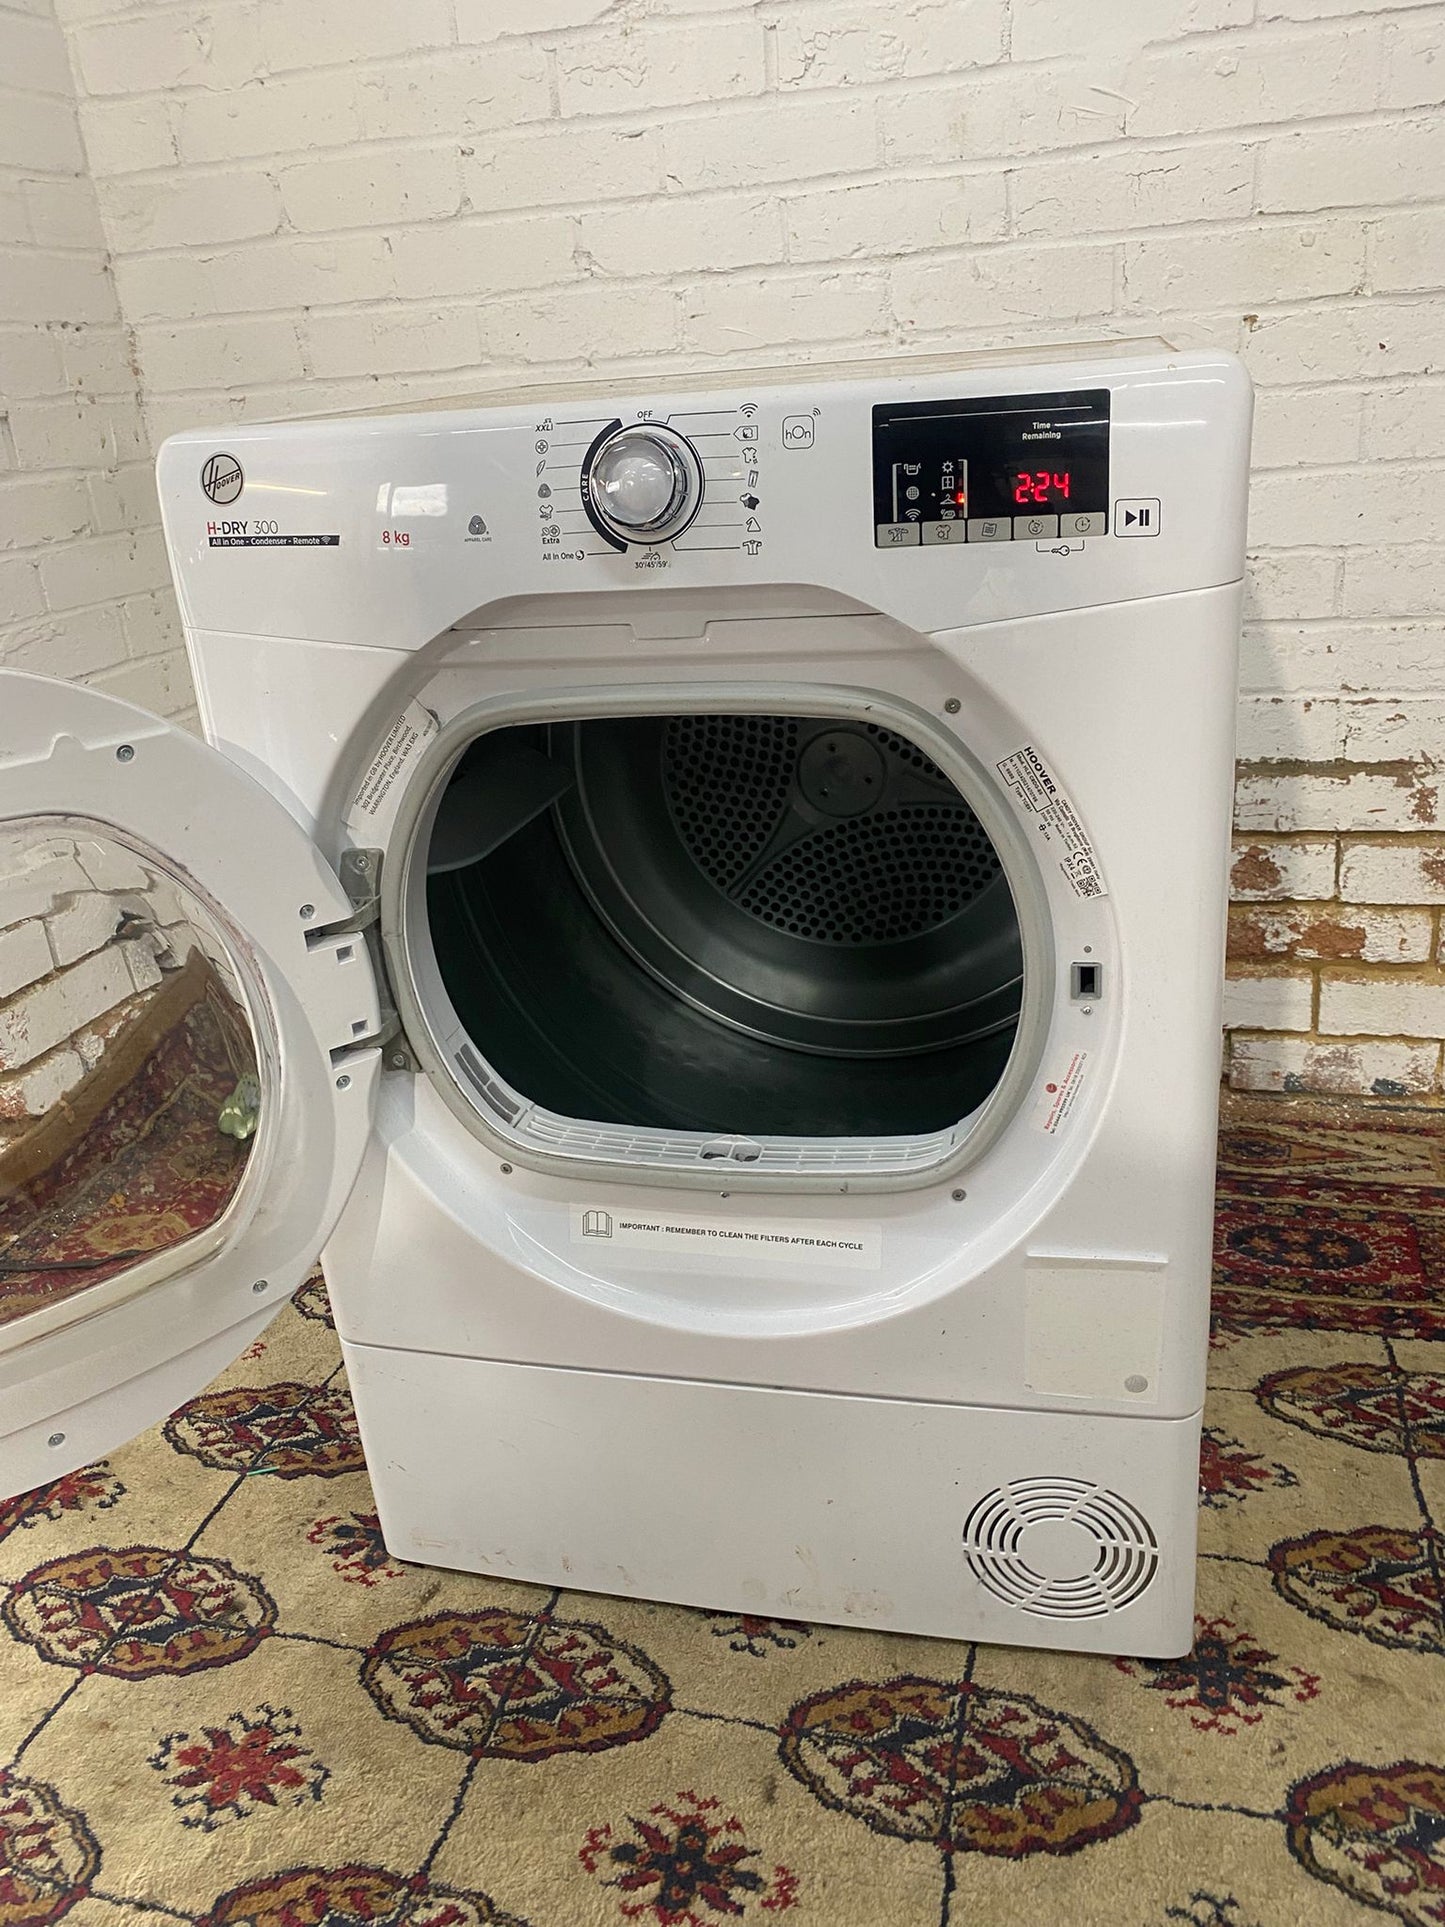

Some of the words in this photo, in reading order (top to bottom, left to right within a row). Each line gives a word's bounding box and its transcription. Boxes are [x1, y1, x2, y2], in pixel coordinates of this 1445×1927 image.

[1022, 431, 1061, 440] Remaining
[1032, 422, 1051, 430] Time
[581, 473, 590, 501] CARE
[1015, 472, 1070, 503] 2:24
[207, 521, 248, 535] H-DRY
[253, 520, 279, 534] 300
[382, 531, 391, 544] 8
[394, 530, 410, 545] kg
[212, 538, 221, 546] All
[231, 537, 244, 545] One
[251, 536, 286, 545] Condenser
[294, 535, 320, 545] Remote
[542, 537, 560, 545] Extra
[543, 553, 551, 561] All
[561, 552, 574, 560] One
[352, 780, 370, 805] Imported
[370, 766, 378, 776] GB
[378, 737, 394, 761] HOOVER
[390, 714, 406, 738] LIMITED
[366, 769, 387, 800] Bridgewater
[383, 755, 396, 770] Place,
[392, 725, 413, 755] Birchwood,
[369, 779, 393, 815] WARRINGTON,
[401, 743, 412, 757] WA3
[1024, 746, 1056, 795] HOOVER
[619, 1222, 660, 1232] IMPORTANT
[665, 1226, 706, 1236] REMEMBER
[707, 1229, 718, 1237] TO
[719, 1230, 743, 1239] CLEAN
[760, 1234, 790, 1243] FILTERS
[791, 1237, 815, 1246] AFTER
[816, 1239, 837, 1247] EACH
[838, 1241, 864, 1251] CYCLE
